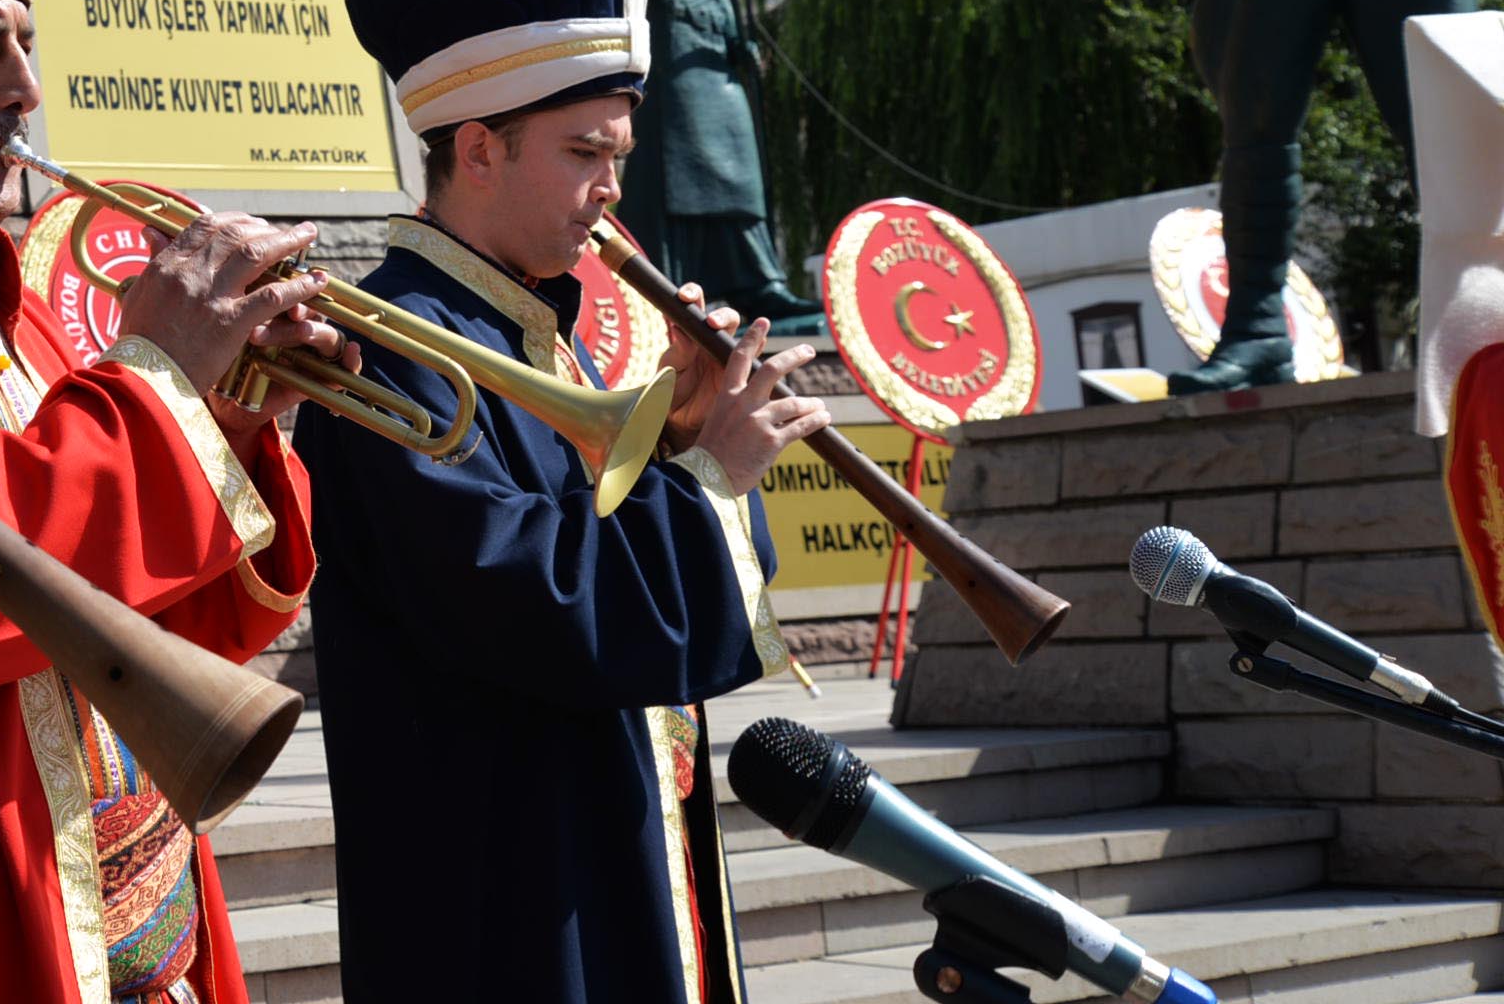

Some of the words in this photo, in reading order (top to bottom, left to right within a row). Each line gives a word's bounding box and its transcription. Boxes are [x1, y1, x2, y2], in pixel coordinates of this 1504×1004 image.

[68, 68, 166, 112] KENDİNDE
[169, 76, 244, 115] KUVVET
[248, 80, 364, 117] BULACAKTIR
[249, 145, 368, 164] M.K.ATATÜRK
[870, 236, 961, 277] BOZÜYÜK
[60, 271, 102, 370] BOZÜYÜ
[802, 521, 896, 559] HALKÇI
